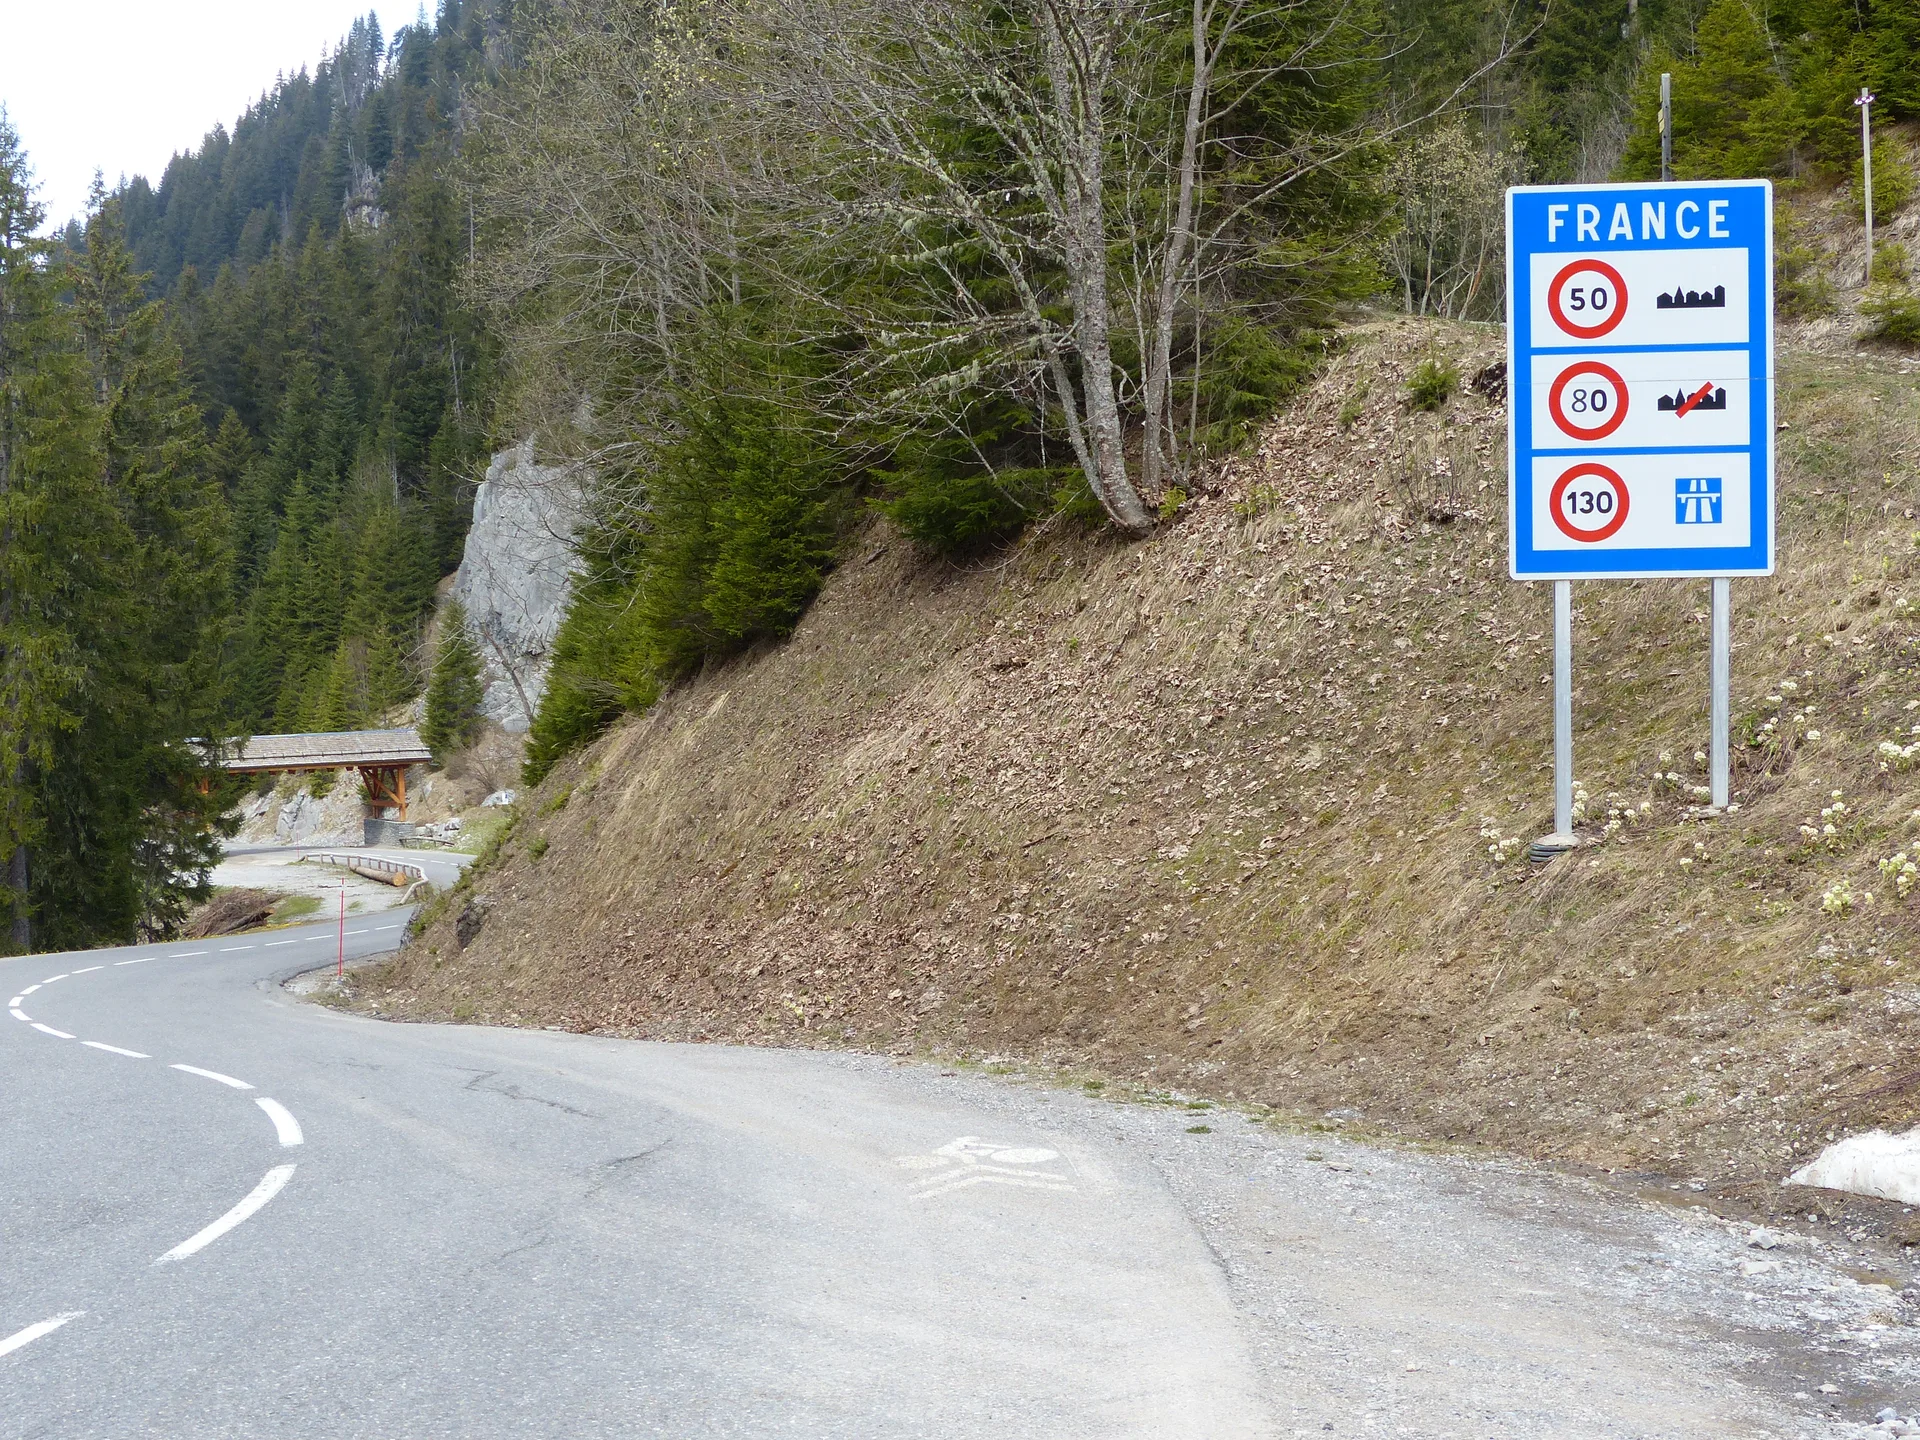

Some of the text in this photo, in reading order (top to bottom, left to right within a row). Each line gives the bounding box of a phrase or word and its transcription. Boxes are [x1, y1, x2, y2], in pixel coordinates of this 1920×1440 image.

[1548, 200, 1730, 242] FRANCE
[1570, 287, 1608, 311] 50
[1571, 389, 1608, 413] 80
[1566, 491, 1613, 515] 130
